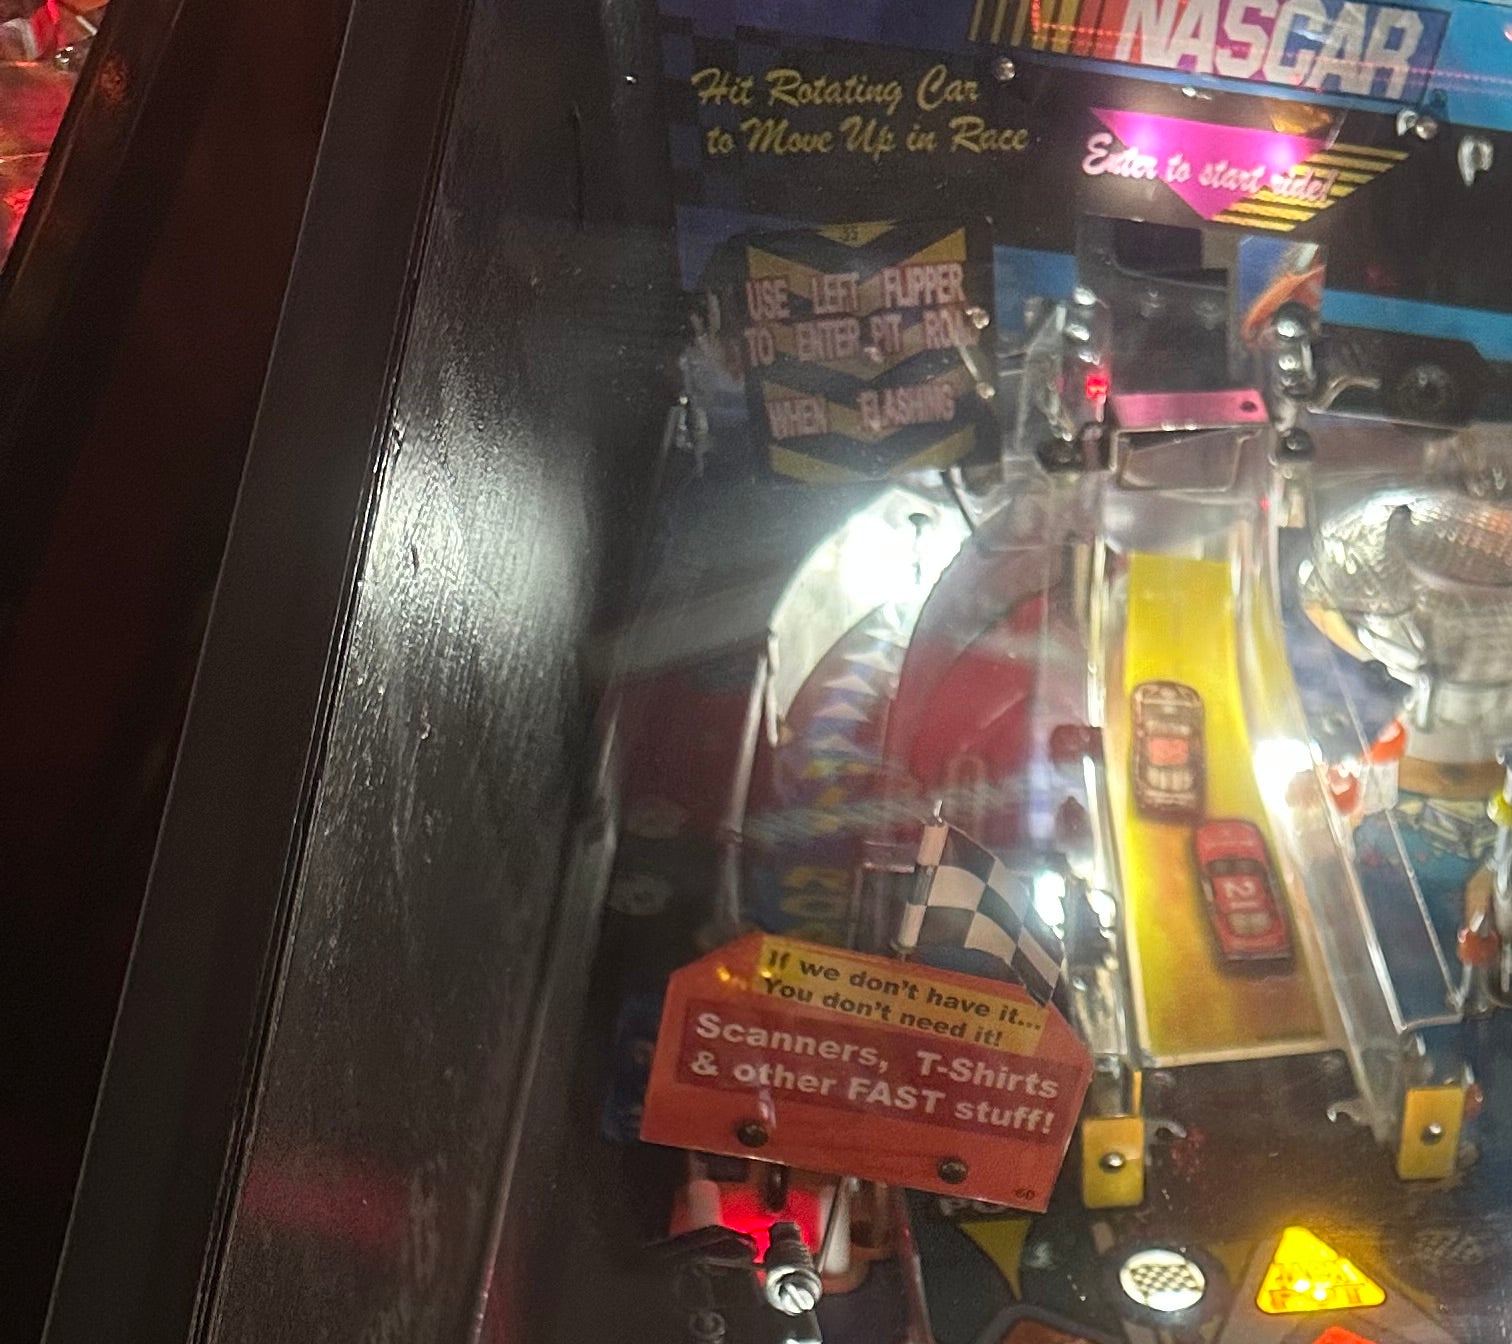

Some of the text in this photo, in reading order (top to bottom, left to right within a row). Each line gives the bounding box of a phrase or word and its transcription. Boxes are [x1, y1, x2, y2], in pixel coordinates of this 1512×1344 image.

[1114, 0, 1422, 98] NASCAR
[691, 63, 979, 115] Hit Rotating Car
[706, 115, 1029, 161] to Move Up in Race
[1082, 132, 1160, 181] Enter
[1166, 155, 1192, 184] to
[1199, 166, 1265, 194] start
[746, 262, 964, 322] USE LEFT FLIPPER
[745, 316, 860, 368] TO ENTER
[764, 384, 956, 440] WHEN FLASHING
[762, 976, 1004, 1048] You don't need it!
[766, 947, 791, 970] If
[799, 958, 840, 983] we
[849, 966, 921, 1003] don't
[926, 986, 992, 1021] have
[695, 1011, 1060, 1102] Scanners, T-Shirts
[690, 1050, 1057, 1136] & other FAST stuff!
